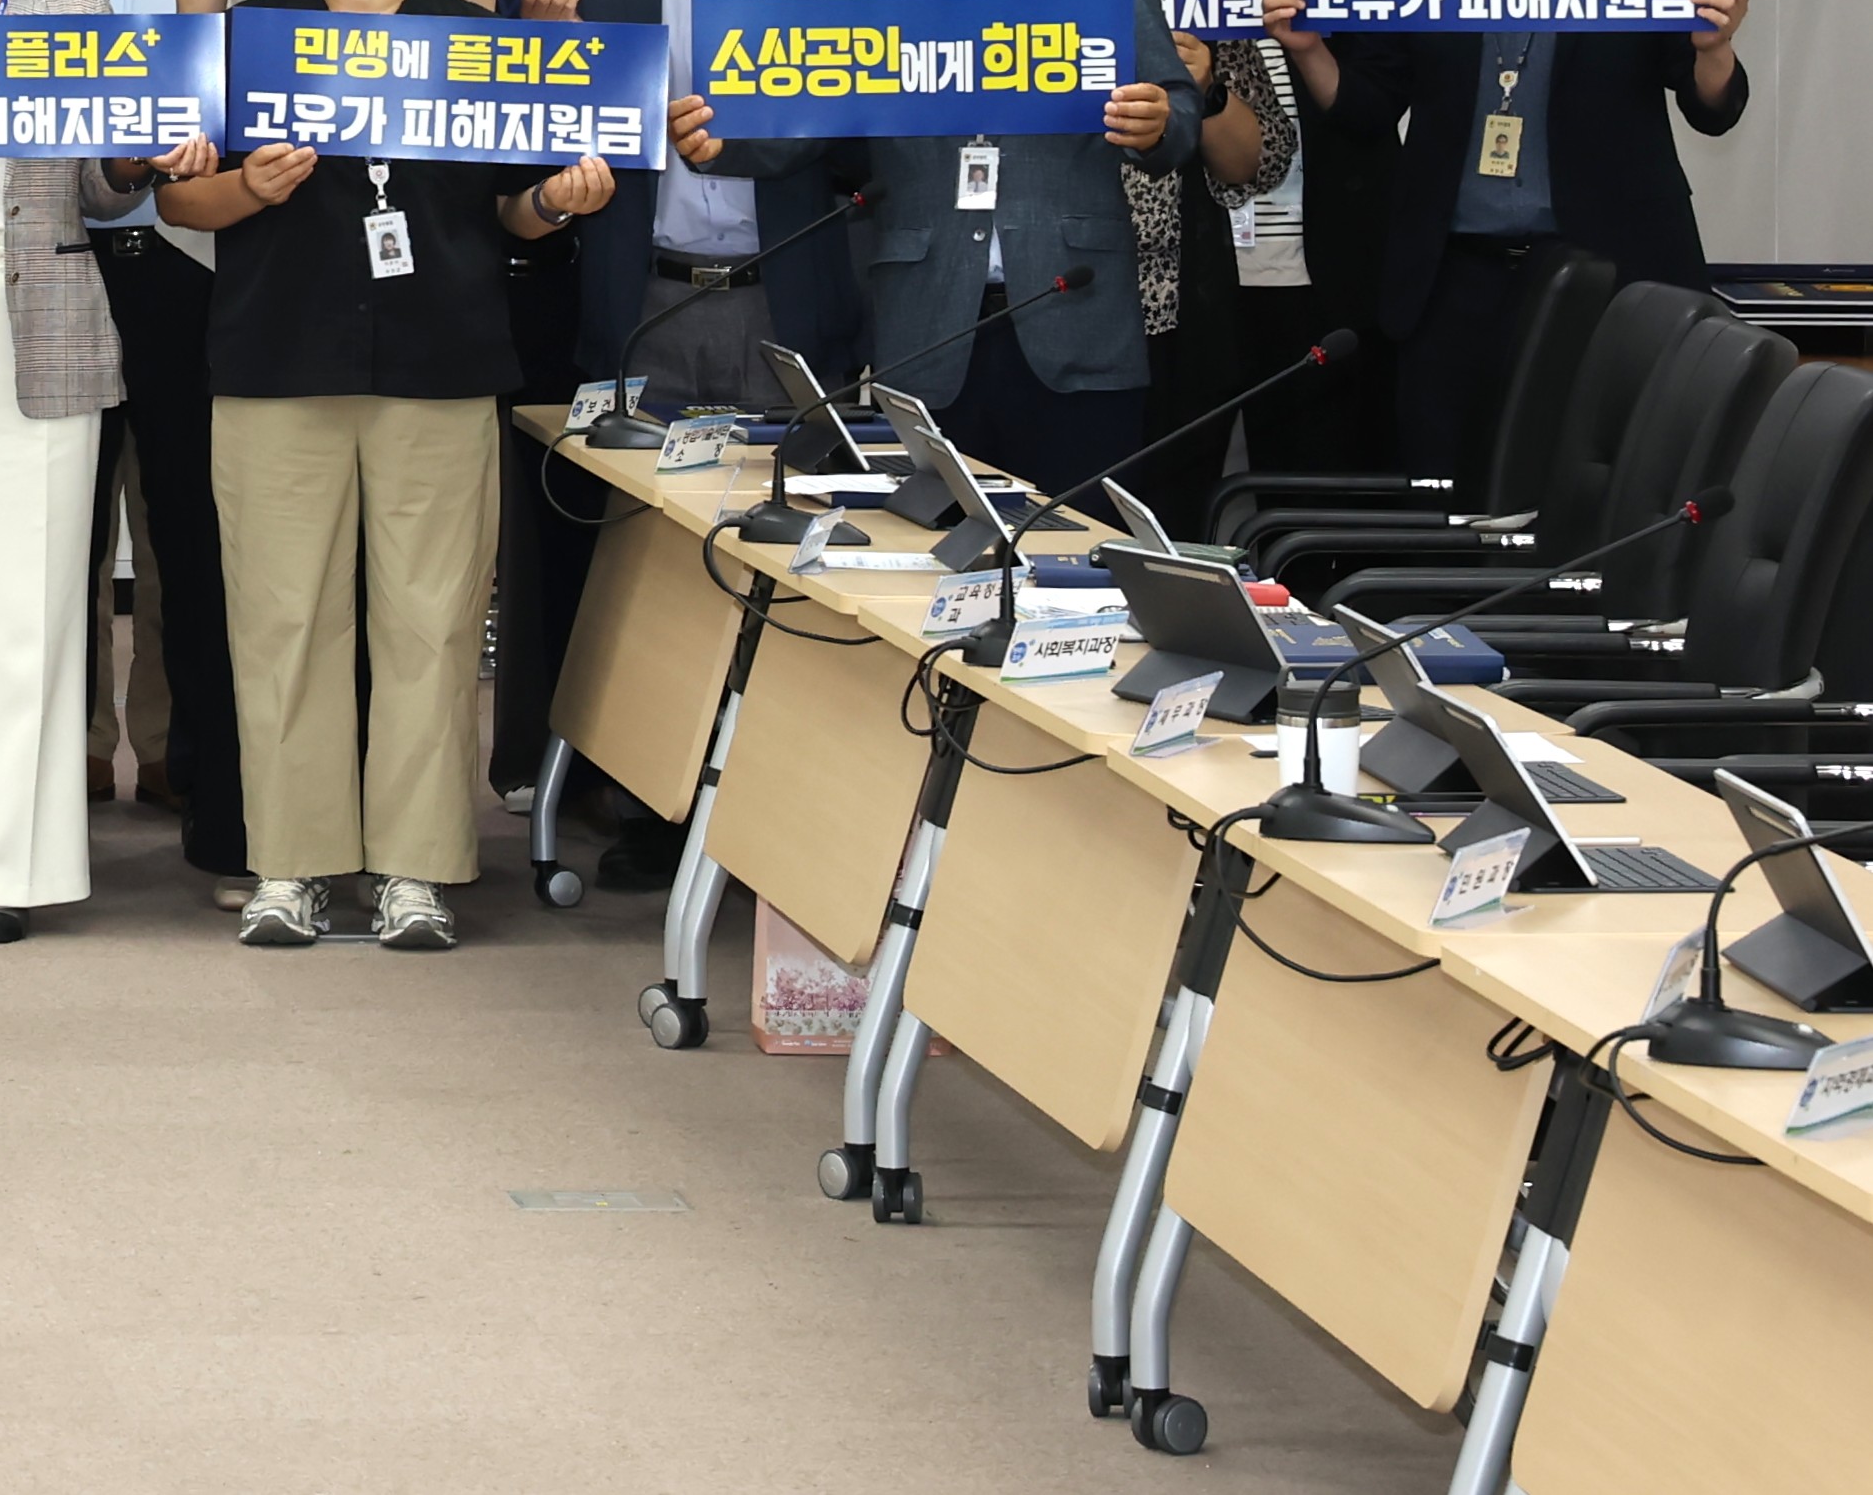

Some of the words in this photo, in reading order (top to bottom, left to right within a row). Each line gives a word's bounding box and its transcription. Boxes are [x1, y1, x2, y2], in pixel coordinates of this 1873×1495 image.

[295, 28, 429, 79] 민생에
[710, 26, 973, 96] 소상공인에게
[982, 23, 1117, 91] 희망을
[245, 92, 387, 146] 고유가
[402, 99, 642, 154] 피해지원금
[1034, 636, 1118, 660] 사회복지과장
